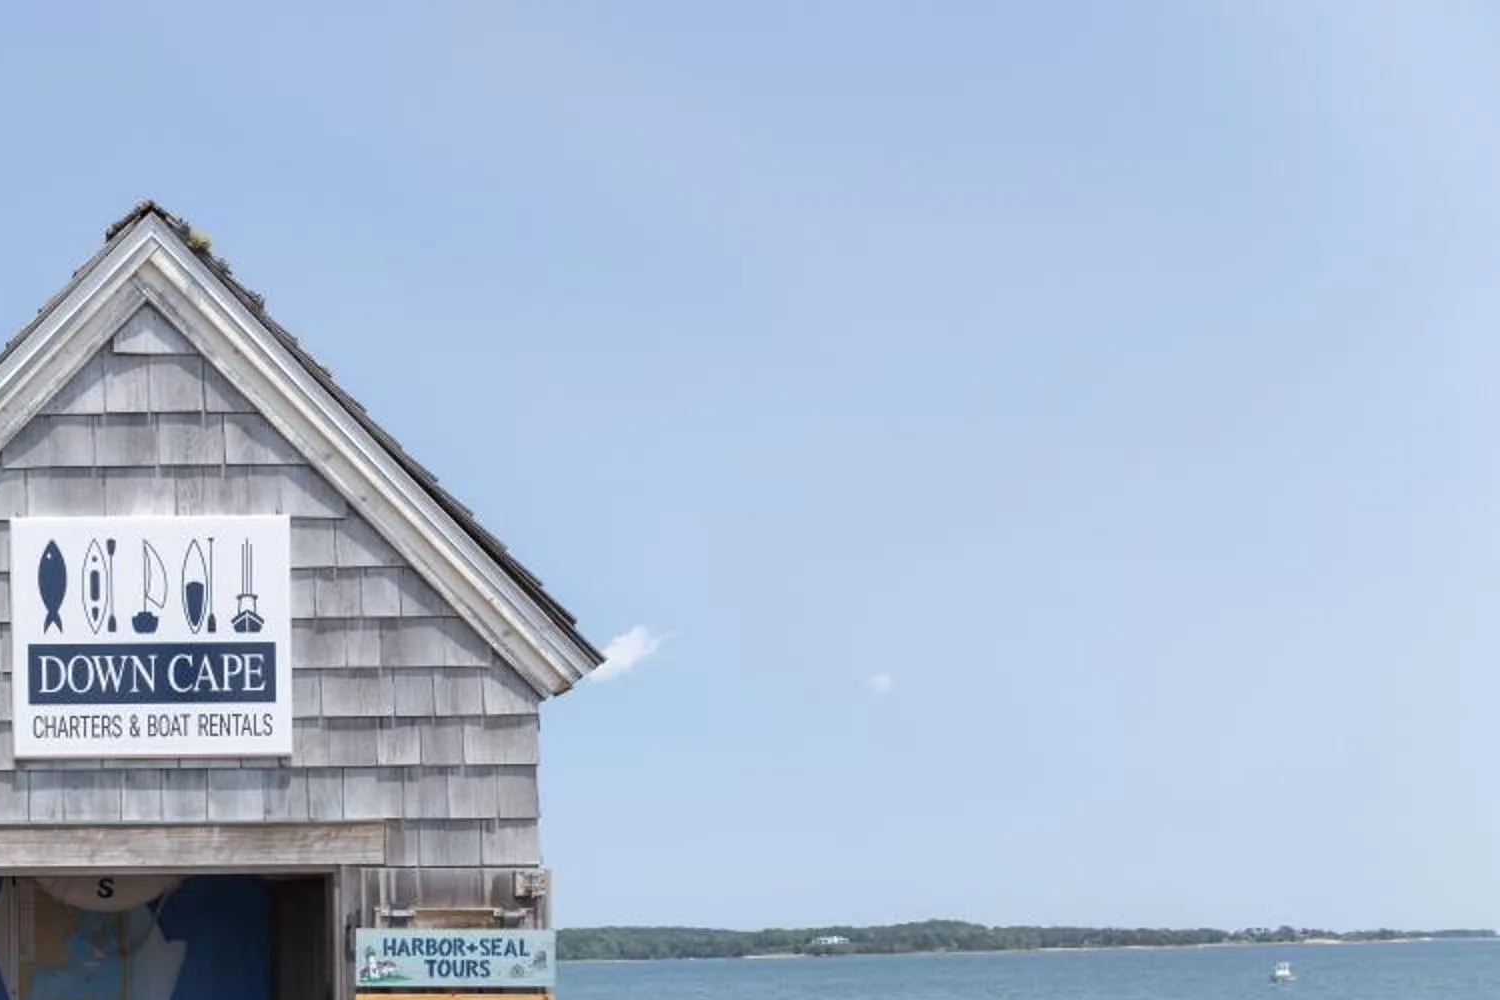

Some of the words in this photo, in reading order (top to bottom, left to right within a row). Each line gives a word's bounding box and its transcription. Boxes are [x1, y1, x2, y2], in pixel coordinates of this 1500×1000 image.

[38, 653, 157, 694] DOWN
[167, 653, 266, 694] CAPE
[32, 714, 123, 739] CHARTERS
[129, 714, 141, 738] &
[147, 713, 190, 738] BOAT
[198, 712, 274, 738] RENTALS
[97, 878, 114, 898] S
[425, 959, 491, 978] TOURS
